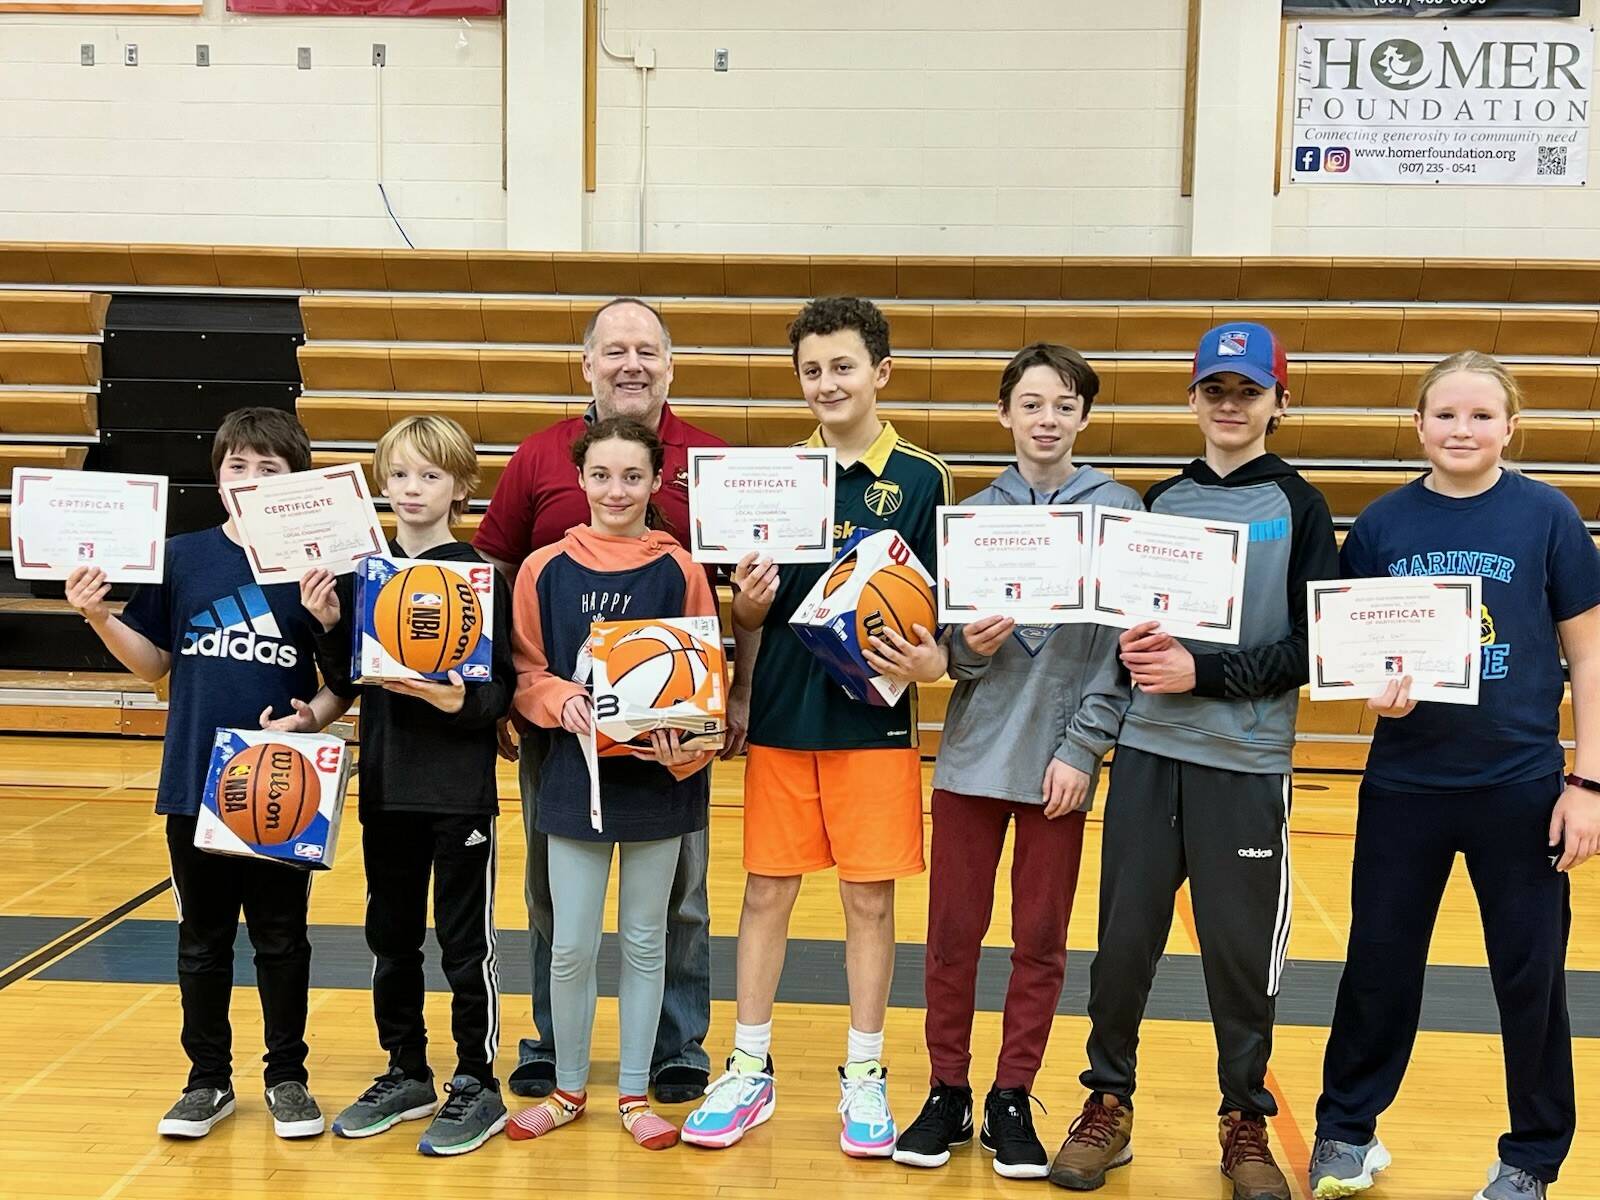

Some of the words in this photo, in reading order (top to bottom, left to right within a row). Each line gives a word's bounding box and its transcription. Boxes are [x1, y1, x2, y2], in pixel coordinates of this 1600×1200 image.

[1298, 46, 1312, 84] The
[1311, 38, 1586, 91] HOMER
[1296, 97, 1589, 122] FOUNDATION
[1304, 128, 1378, 144] Connecting
[1382, 130, 1450, 144] generosity
[1453, 131, 1466, 142] to
[1470, 131, 1542, 144] community
[1545, 130, 1578, 143] need
[1354, 147, 1516, 162] www.homerfoundation.org
[1398, 162, 1424, 174] (907)
[1426, 162, 1444, 173] 235
[1452, 162, 1476, 173] 0541
[723, 479, 798, 488] CERTIFICATE
[49, 499, 125, 511] CERTIFICATE
[264, 497, 335, 515] CERTIFICATE
[974, 537, 1051, 546] CERTIFICATE
[1127, 543, 1204, 560] CERTIFICATE
[1388, 551, 1516, 583] MARINER
[582, 591, 632, 614] HAPPY
[410, 607, 441, 640] NBA
[451, 583, 476, 661] Wilson
[1350, 608, 1437, 621] CERTIFICATE
[181, 627, 297, 668] adidas
[224, 778, 248, 813] NBA
[265, 751, 292, 830] Wilson
[1238, 848, 1273, 858] adidas
